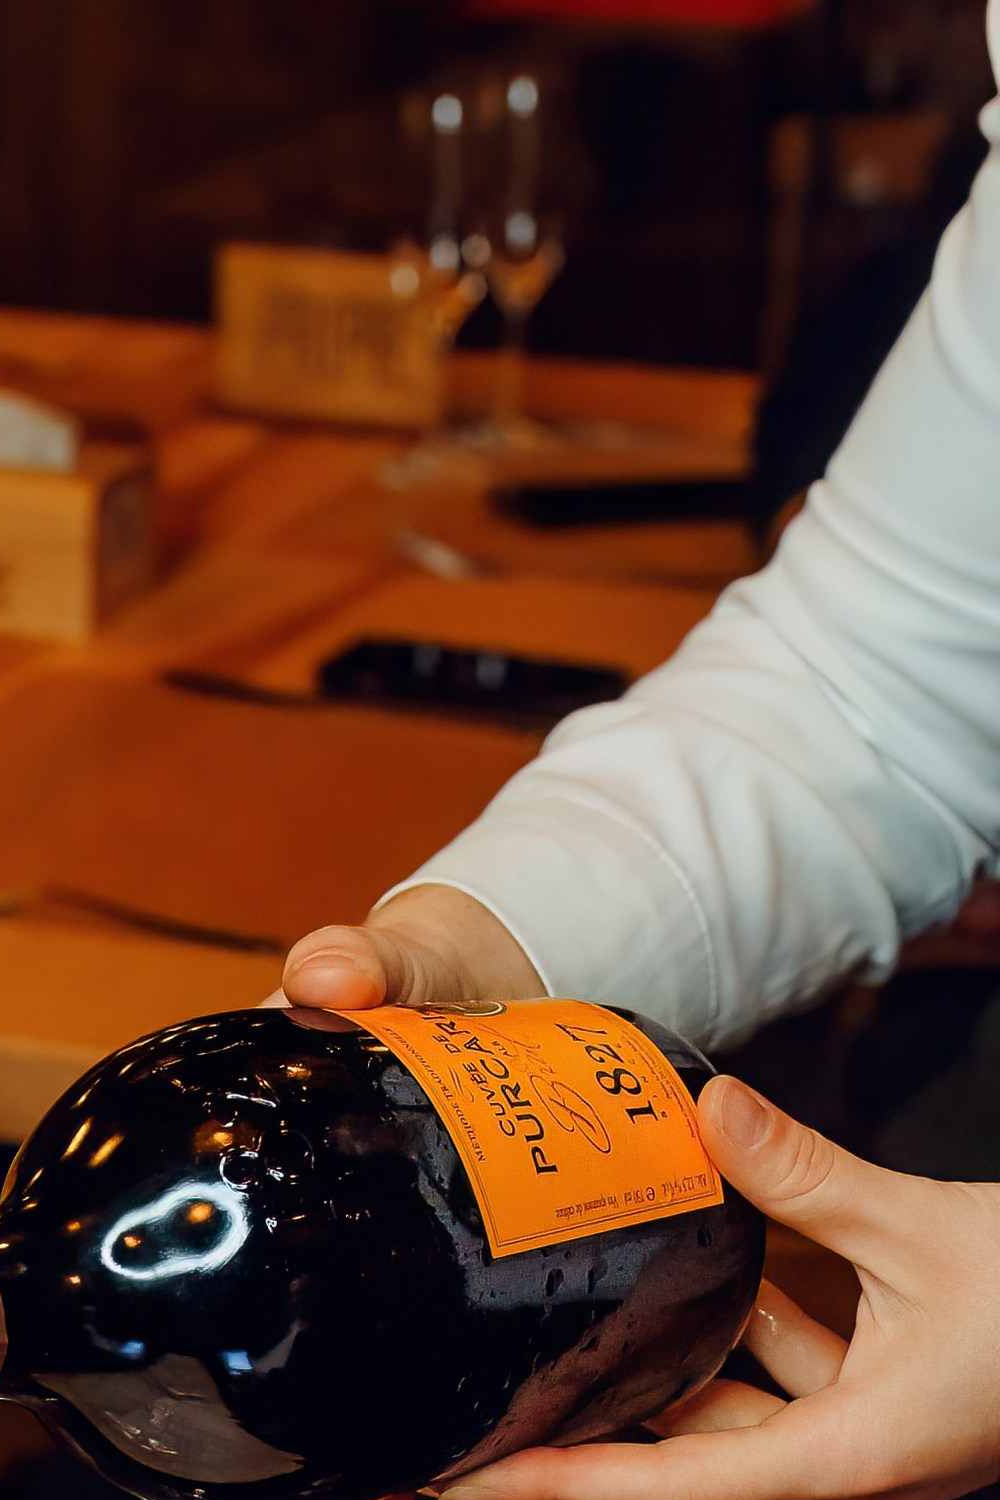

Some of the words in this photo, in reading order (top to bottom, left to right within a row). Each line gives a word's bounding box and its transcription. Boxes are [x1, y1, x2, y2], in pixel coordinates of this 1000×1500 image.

[421, 1014, 559, 1175] PURCARI
[432, 1034, 462, 1055] DE
[554, 1022, 659, 1124] 1827
